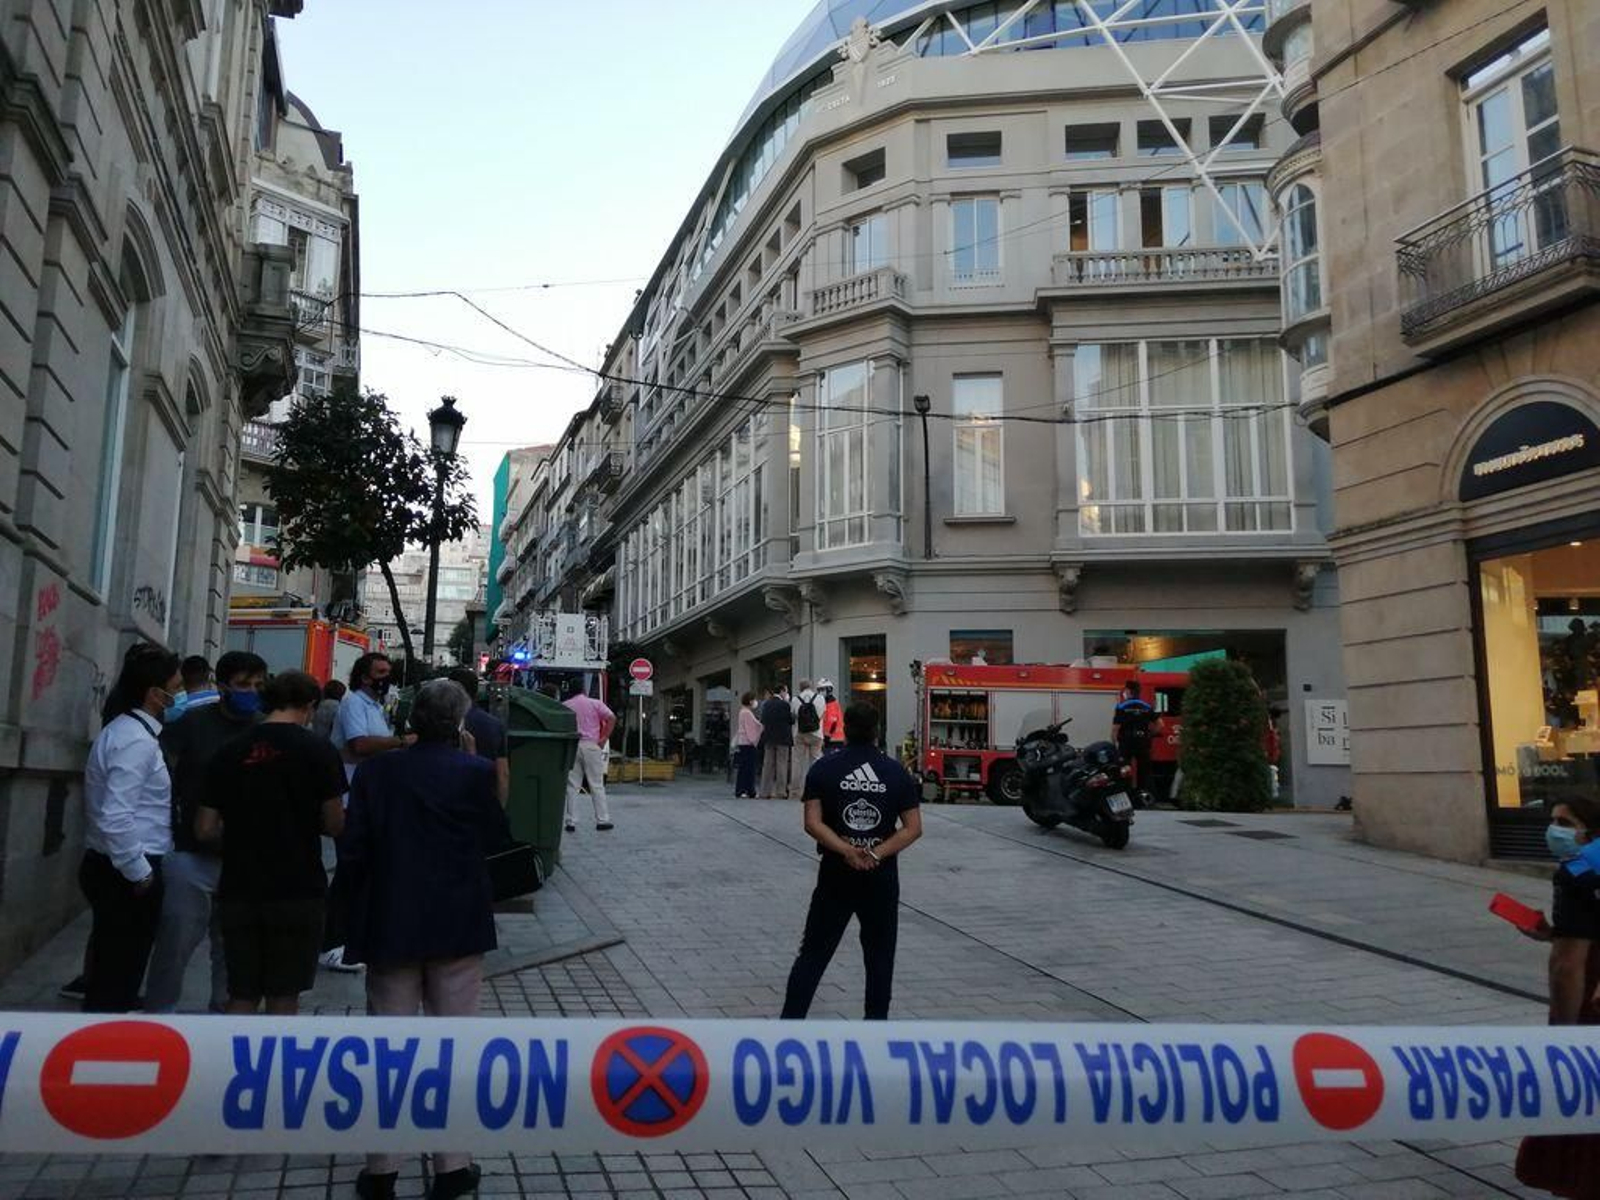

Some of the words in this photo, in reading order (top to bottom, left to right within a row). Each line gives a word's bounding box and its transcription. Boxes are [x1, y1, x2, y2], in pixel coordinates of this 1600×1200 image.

[1318, 732, 1335, 745] ba
[840, 780, 887, 793] adidas
[222, 1036, 454, 1131] PASAR
[476, 1037, 568, 1130] NO
[732, 1038, 875, 1126] VIGO
[887, 1040, 1066, 1125] LOCAL
[1074, 1042, 1279, 1124] POLICIA
[1391, 1045, 1541, 1120] PASAR
